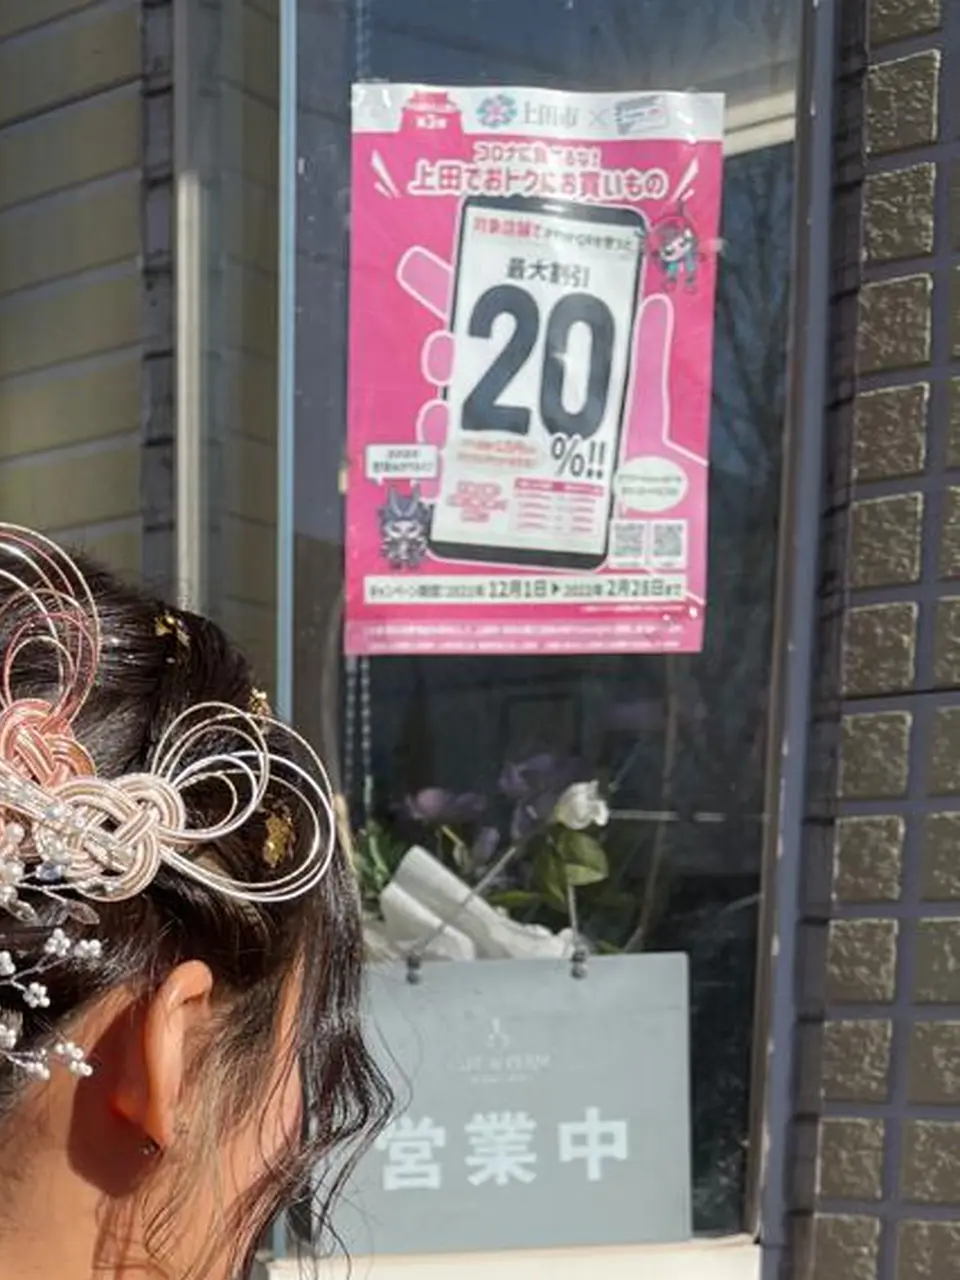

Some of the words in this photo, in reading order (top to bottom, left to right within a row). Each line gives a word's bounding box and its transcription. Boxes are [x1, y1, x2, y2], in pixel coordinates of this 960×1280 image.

[410, 161, 668, 200] 上田でおトクにお買いもの
[506, 257, 591, 289] 最大割引
[376, 1105, 630, 1192] 営業中
